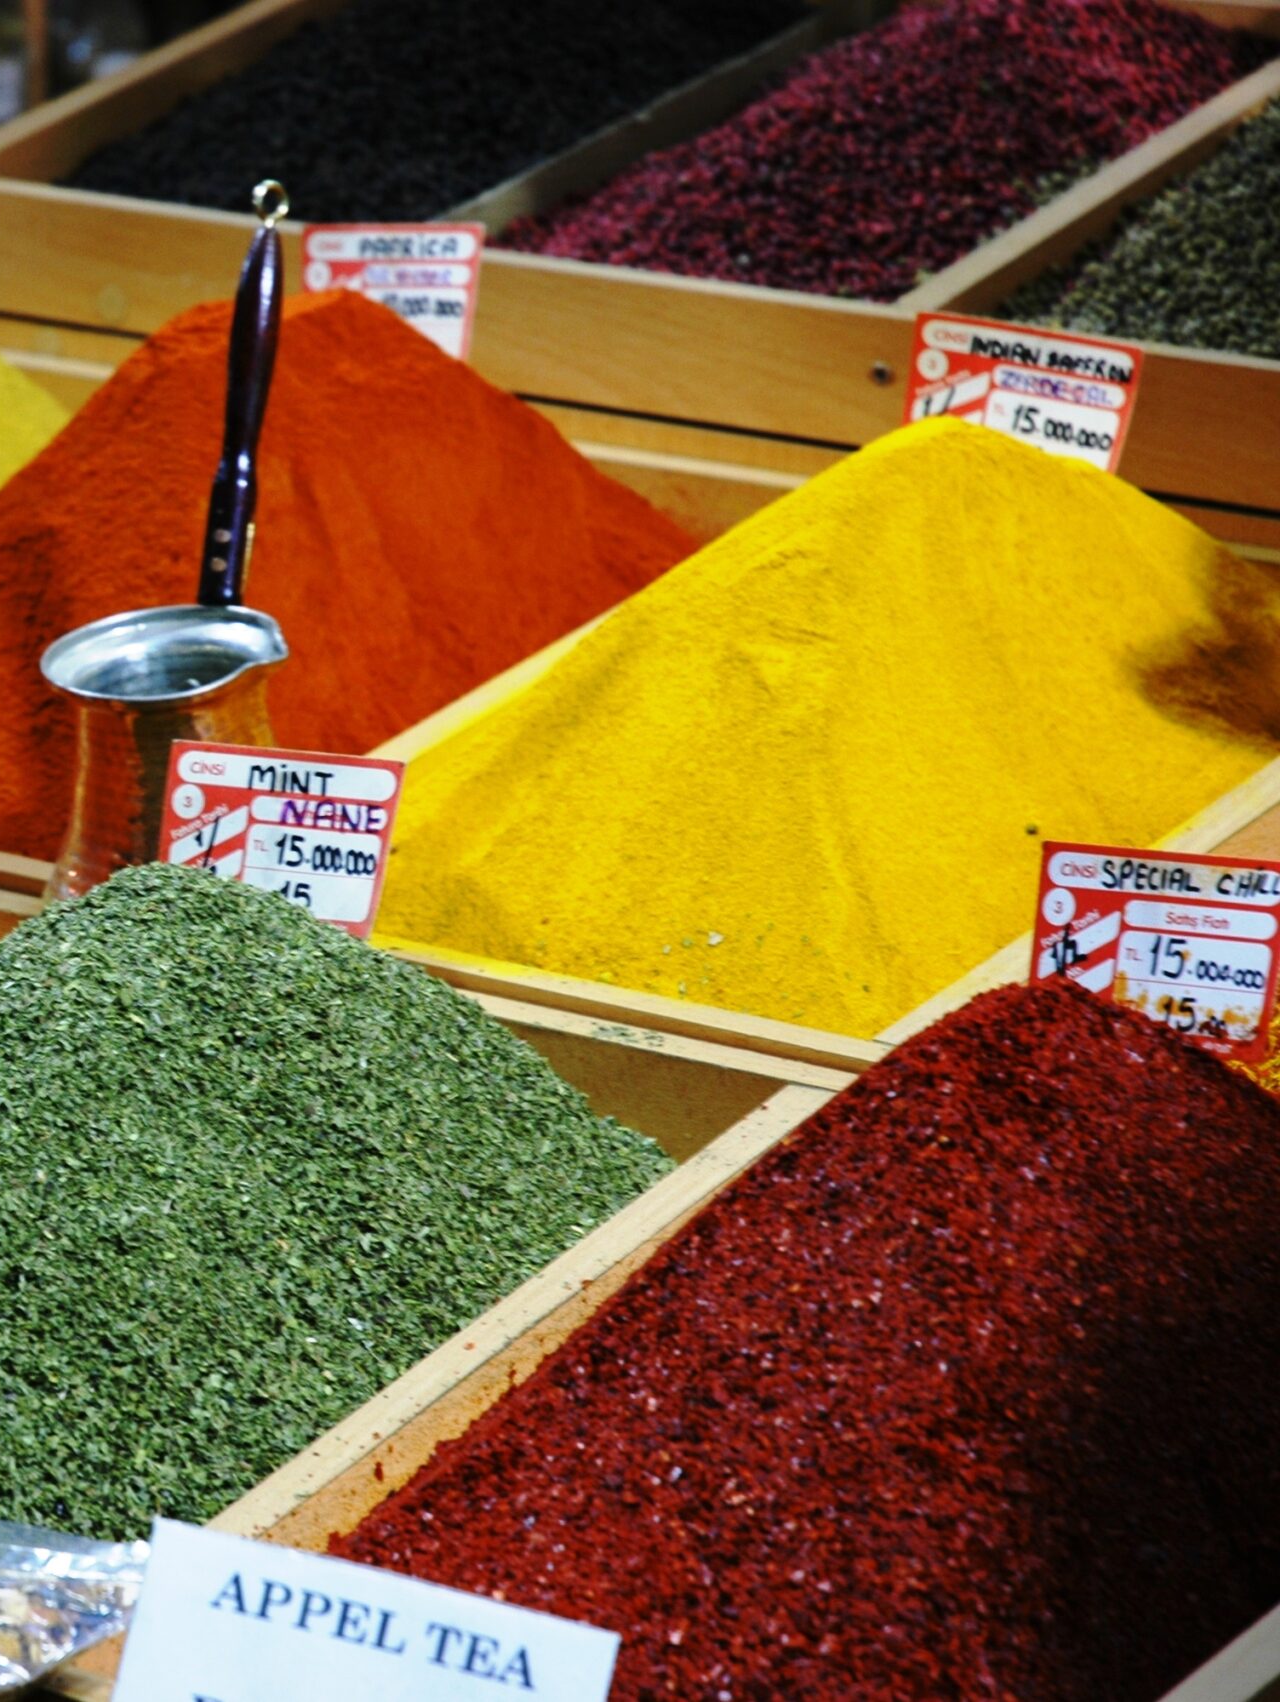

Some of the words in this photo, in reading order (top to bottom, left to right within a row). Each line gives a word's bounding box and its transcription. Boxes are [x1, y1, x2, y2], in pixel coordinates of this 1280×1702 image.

[280, 799, 384, 834] NANE
[1102, 859, 1201, 892] SPECIAL
[210, 1571, 406, 1655] APPEL
[425, 1621, 536, 1691] TEA
